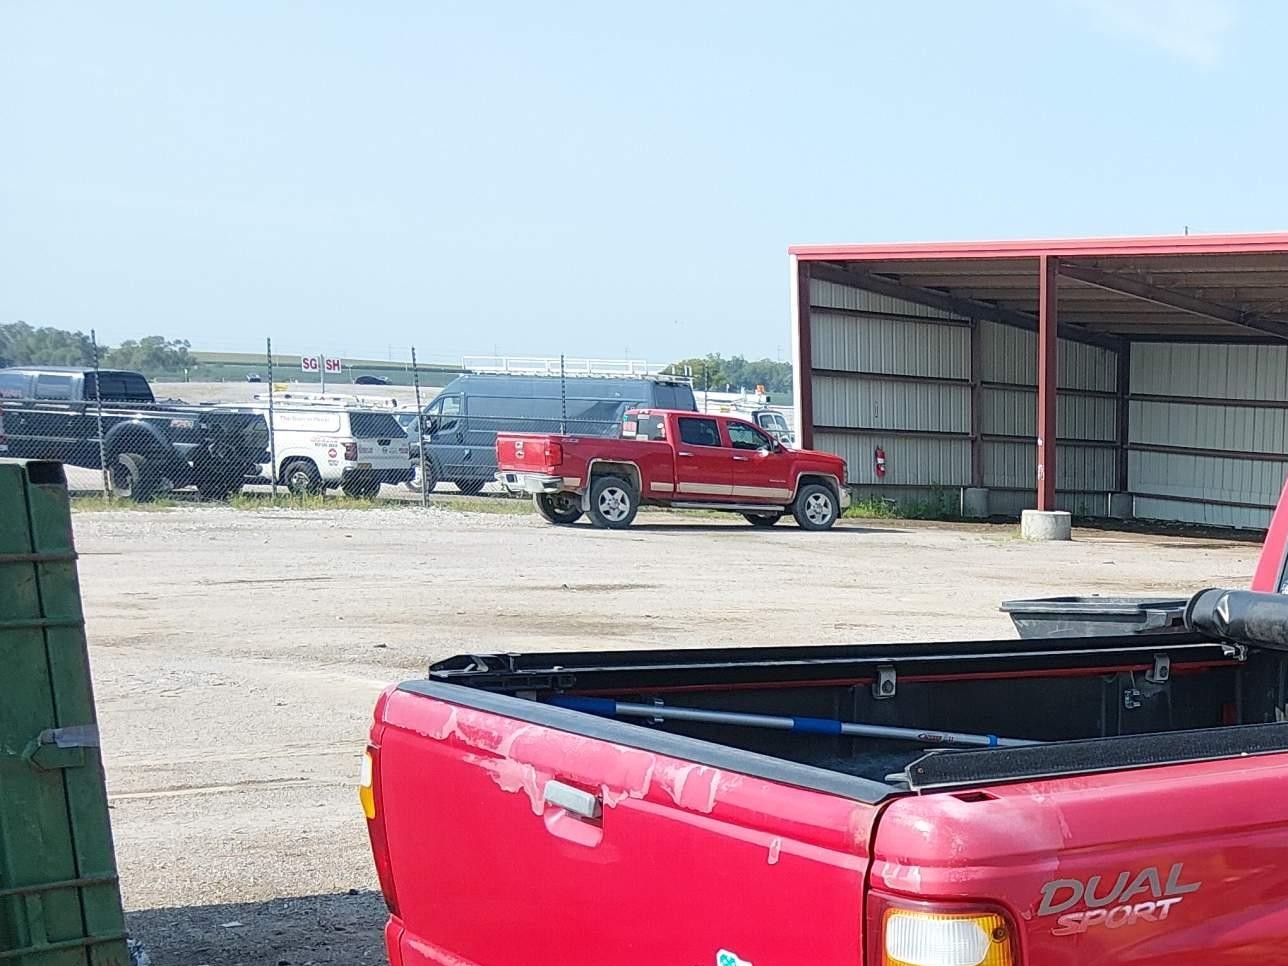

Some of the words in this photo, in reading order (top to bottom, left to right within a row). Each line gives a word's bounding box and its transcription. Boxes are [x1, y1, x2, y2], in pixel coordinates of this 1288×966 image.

[303, 358, 318, 370] SG
[326, 359, 340, 370] SH
[1038, 863, 1202, 916] DUAL
[1051, 897, 1183, 936] SPORT
